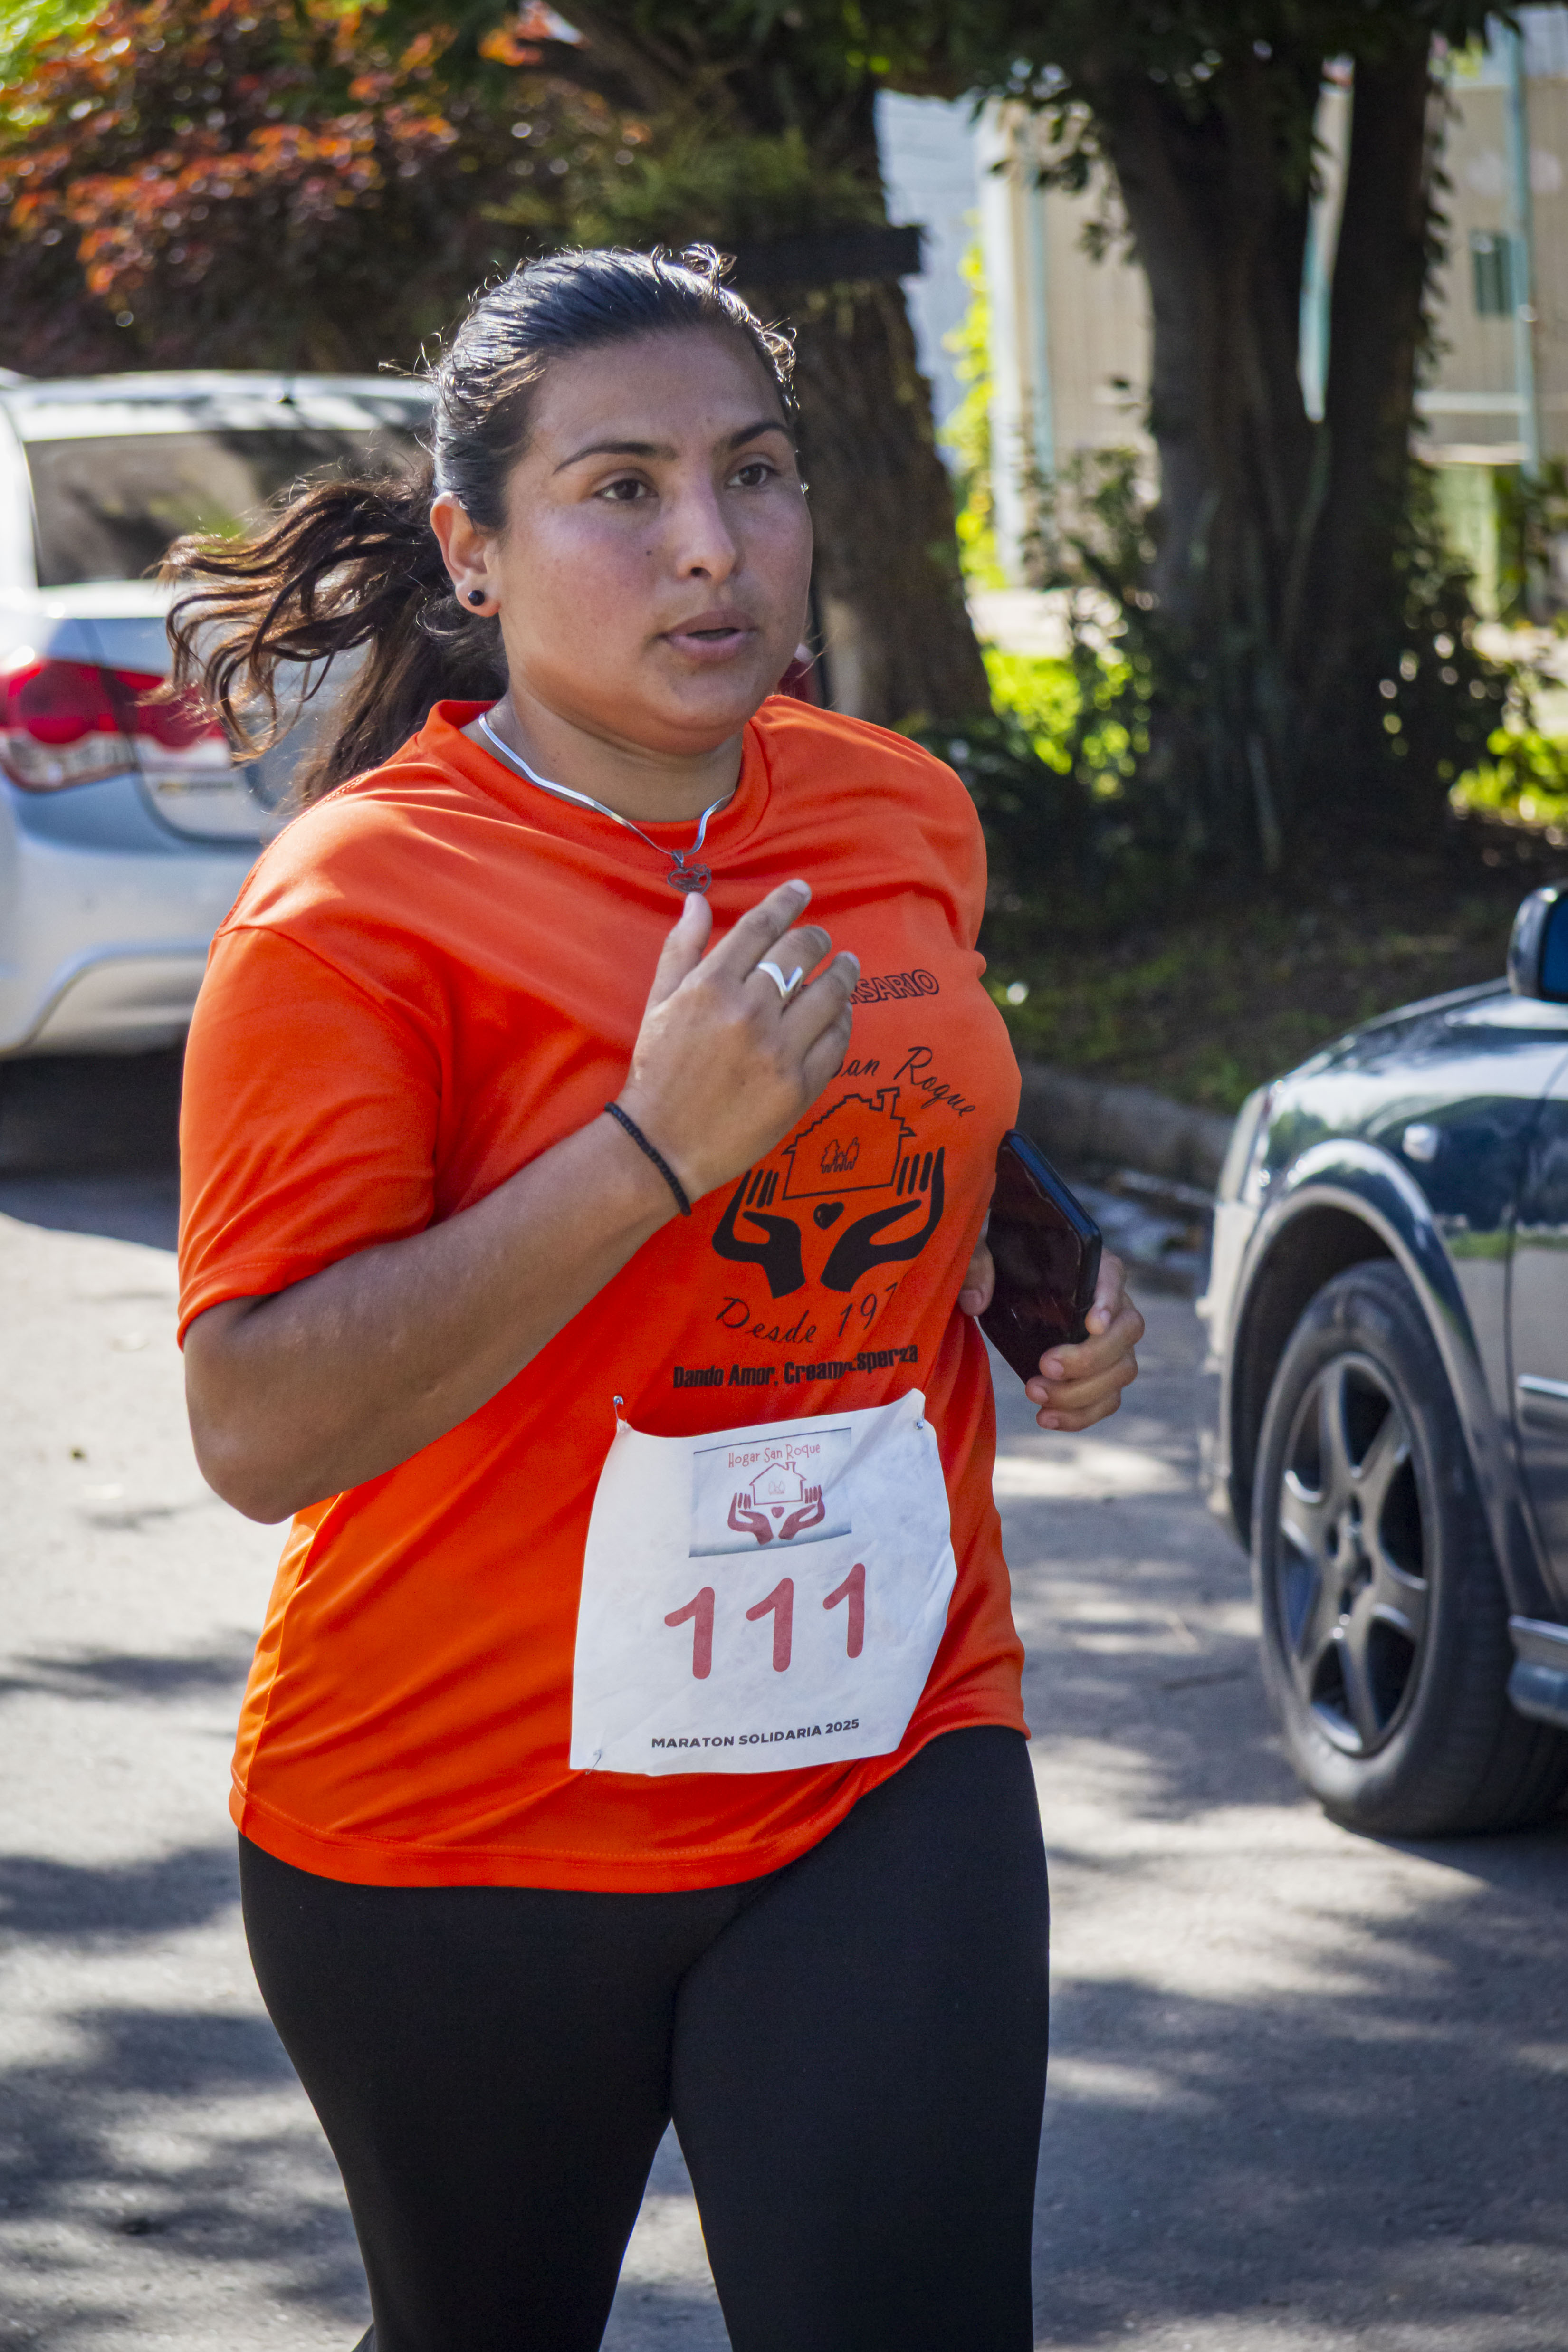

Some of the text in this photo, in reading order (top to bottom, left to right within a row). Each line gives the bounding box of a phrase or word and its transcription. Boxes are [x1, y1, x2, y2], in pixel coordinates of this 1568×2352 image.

[716, 1297, 817, 1343] Desde
[673, 1365, 725, 1388] Dando
[728, 1444, 820, 1468] Hogar San Roque
[665, 1563, 866, 1680] 111
[651, 1718, 860, 1748] MARATON SOLIDARIA 2025
